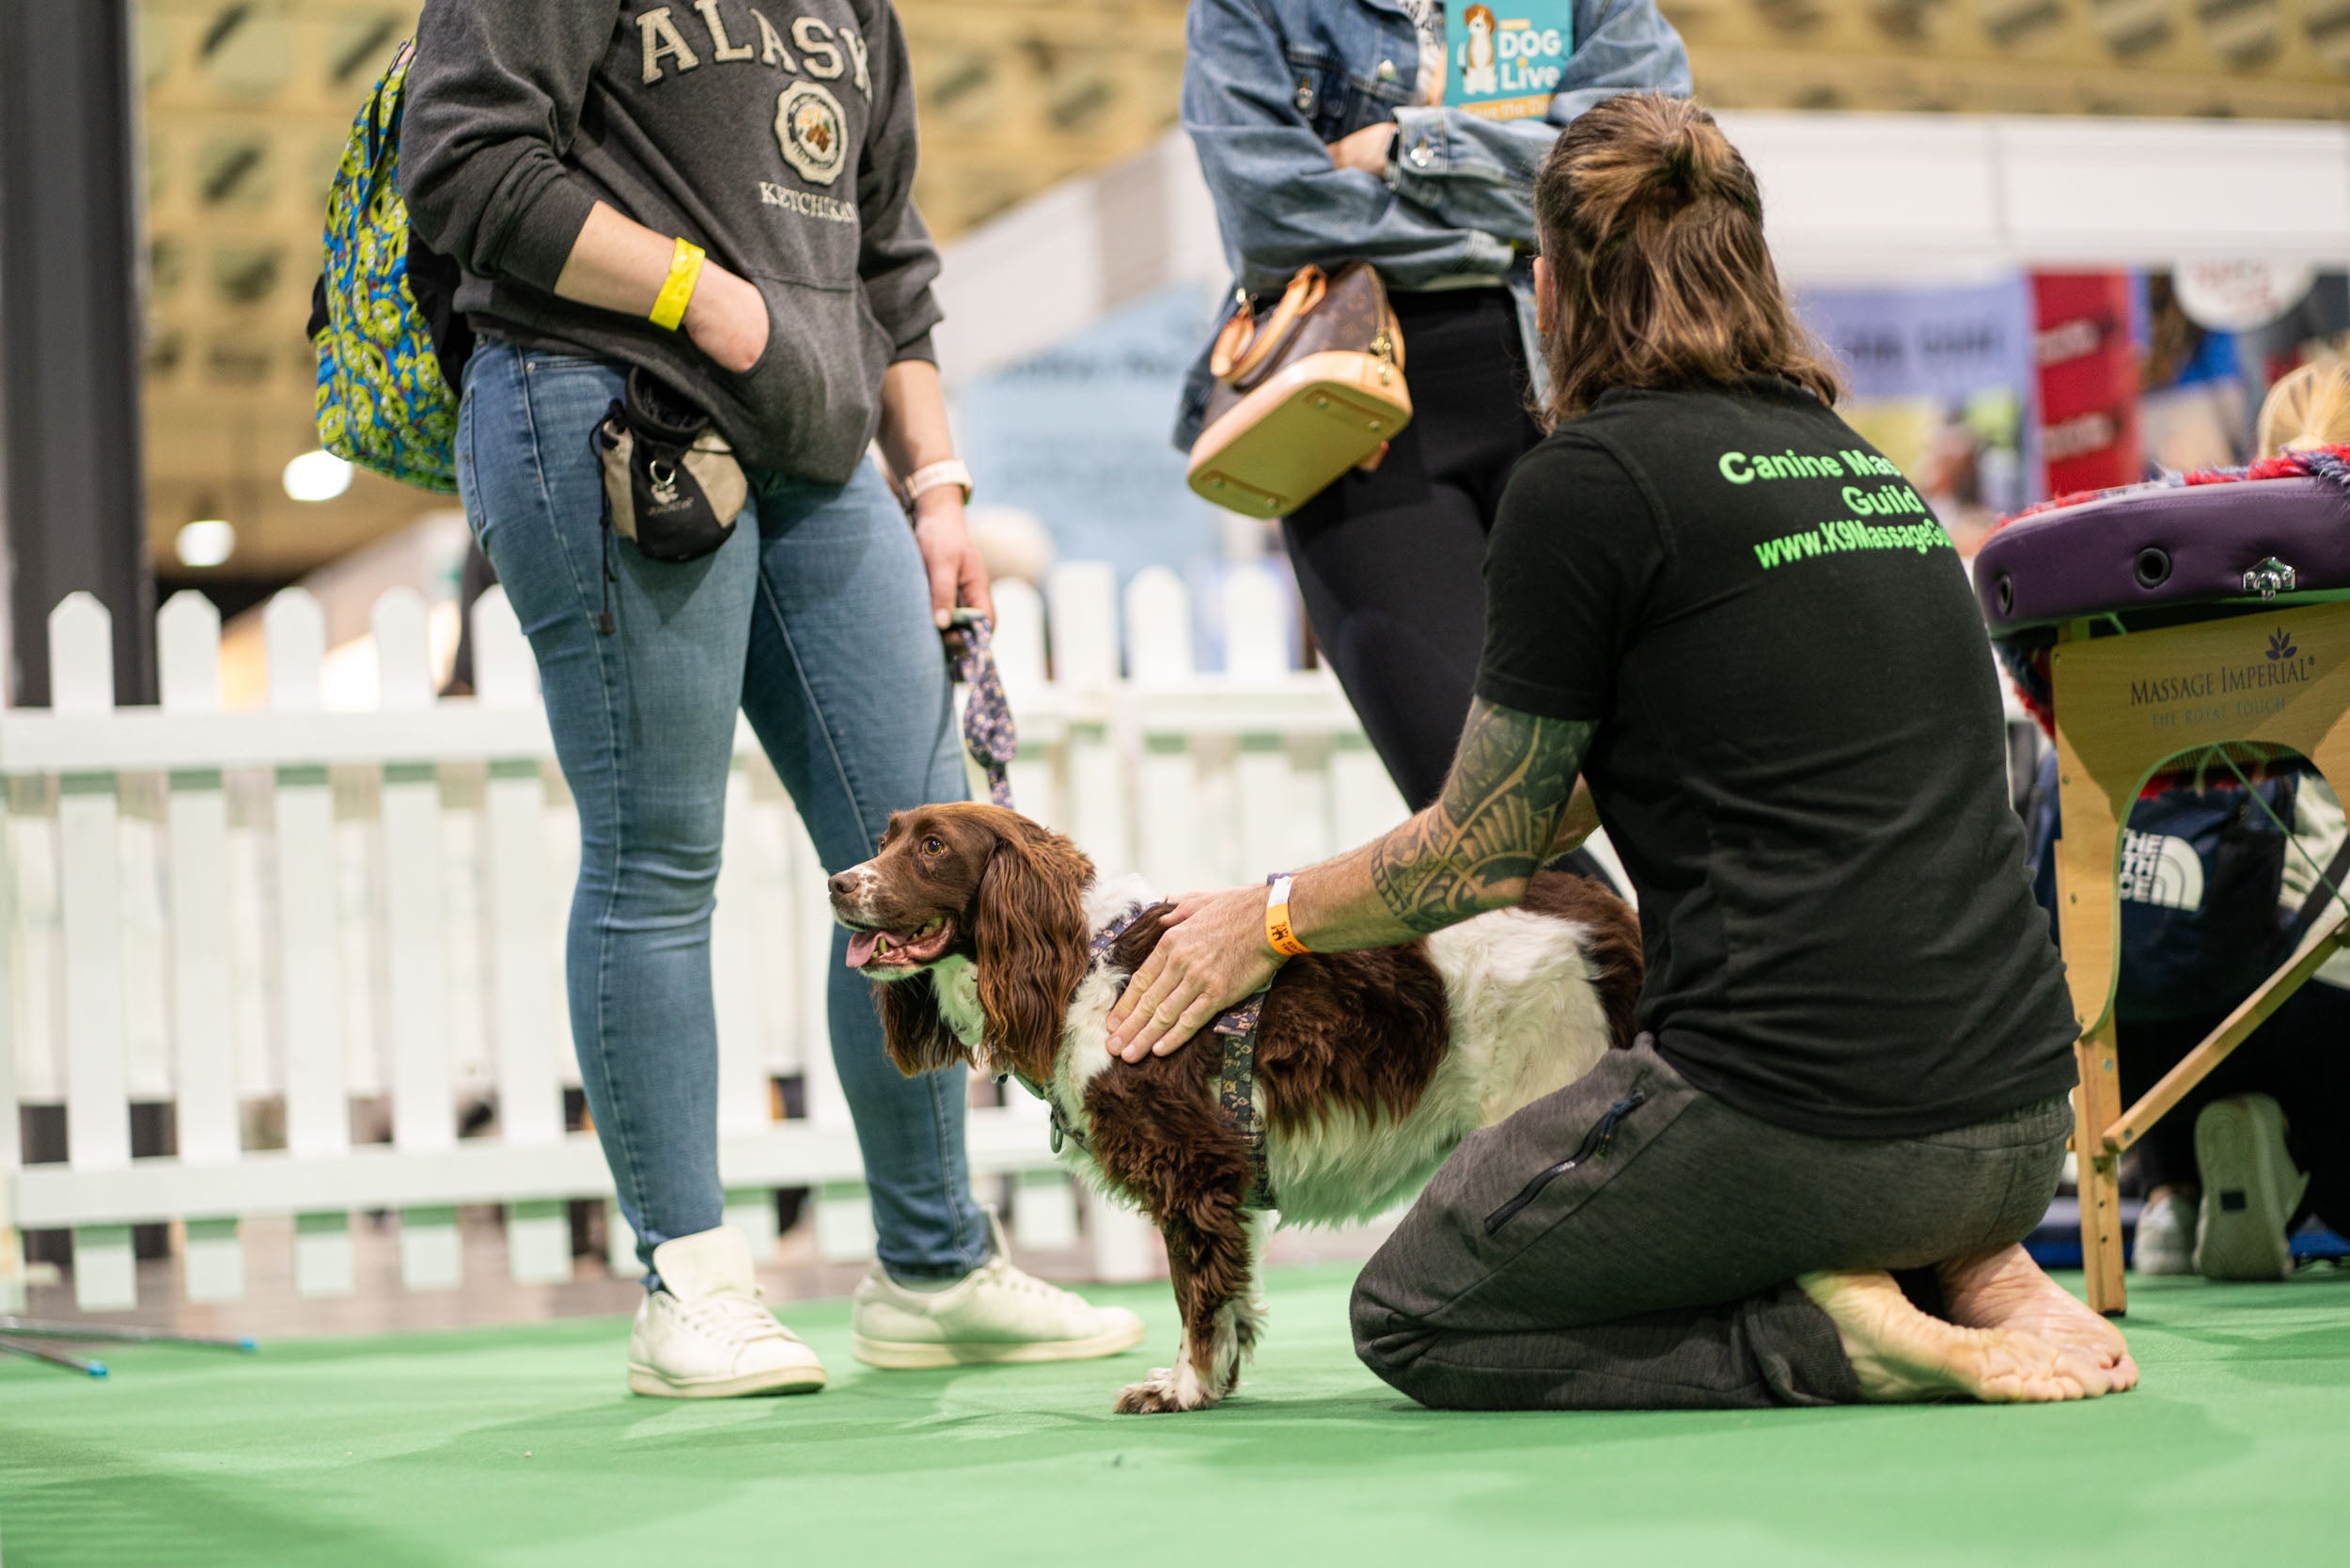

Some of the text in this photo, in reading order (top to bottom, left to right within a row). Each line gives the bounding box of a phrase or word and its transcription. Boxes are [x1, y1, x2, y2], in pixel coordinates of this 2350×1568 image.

[1498, 27, 1562, 59] DOG
[1500, 56, 1560, 90] Live
[1718, 448, 1844, 485] Canine
[1841, 484, 1926, 515] Guild
[2130, 671, 2216, 706] MASSAGE
[2185, 706, 2227, 725] ROYAL
[2236, 698, 2286, 716] TOUCH
